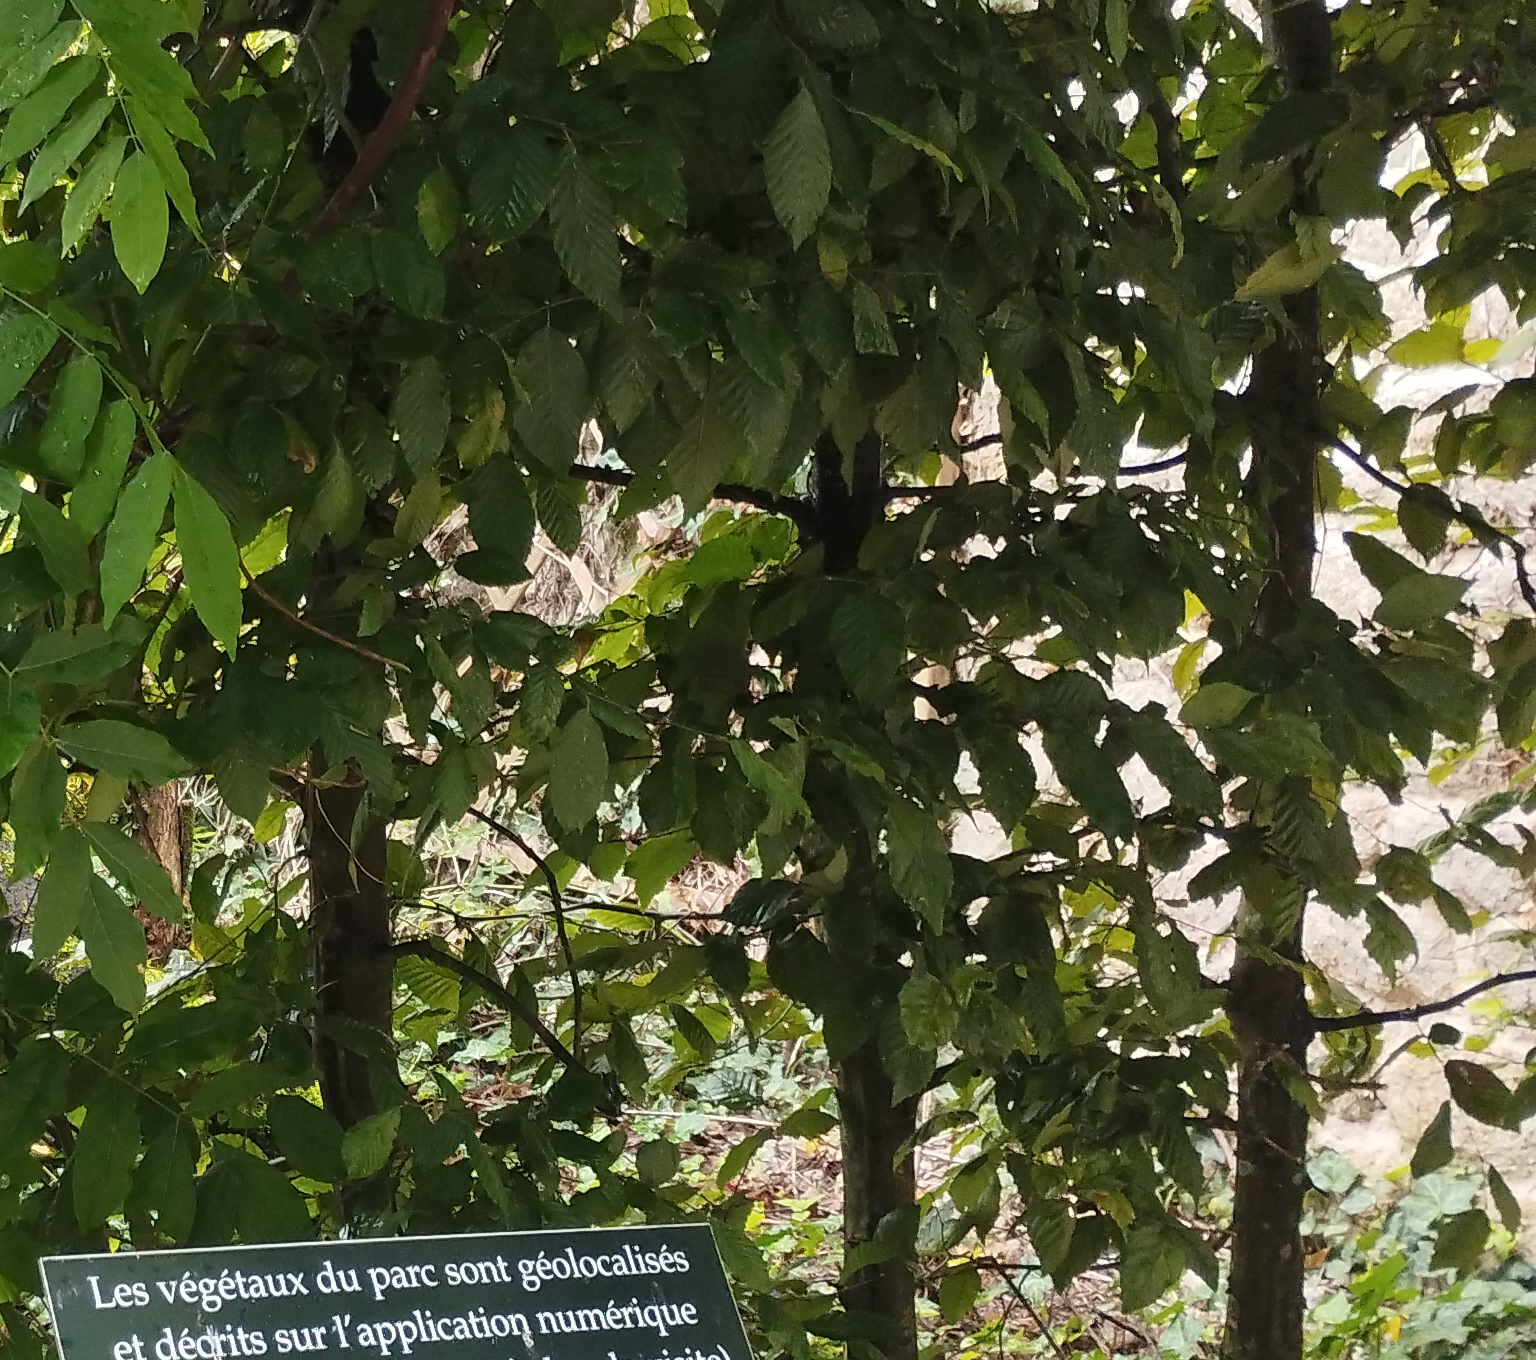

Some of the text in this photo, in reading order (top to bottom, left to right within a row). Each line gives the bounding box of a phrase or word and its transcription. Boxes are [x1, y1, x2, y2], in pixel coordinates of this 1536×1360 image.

[87, 1243, 690, 1313] Les végétaux du parc sont géolocalisés
[275, 1326, 328, 1354] sur
[536, 1298, 699, 1337] numérique
